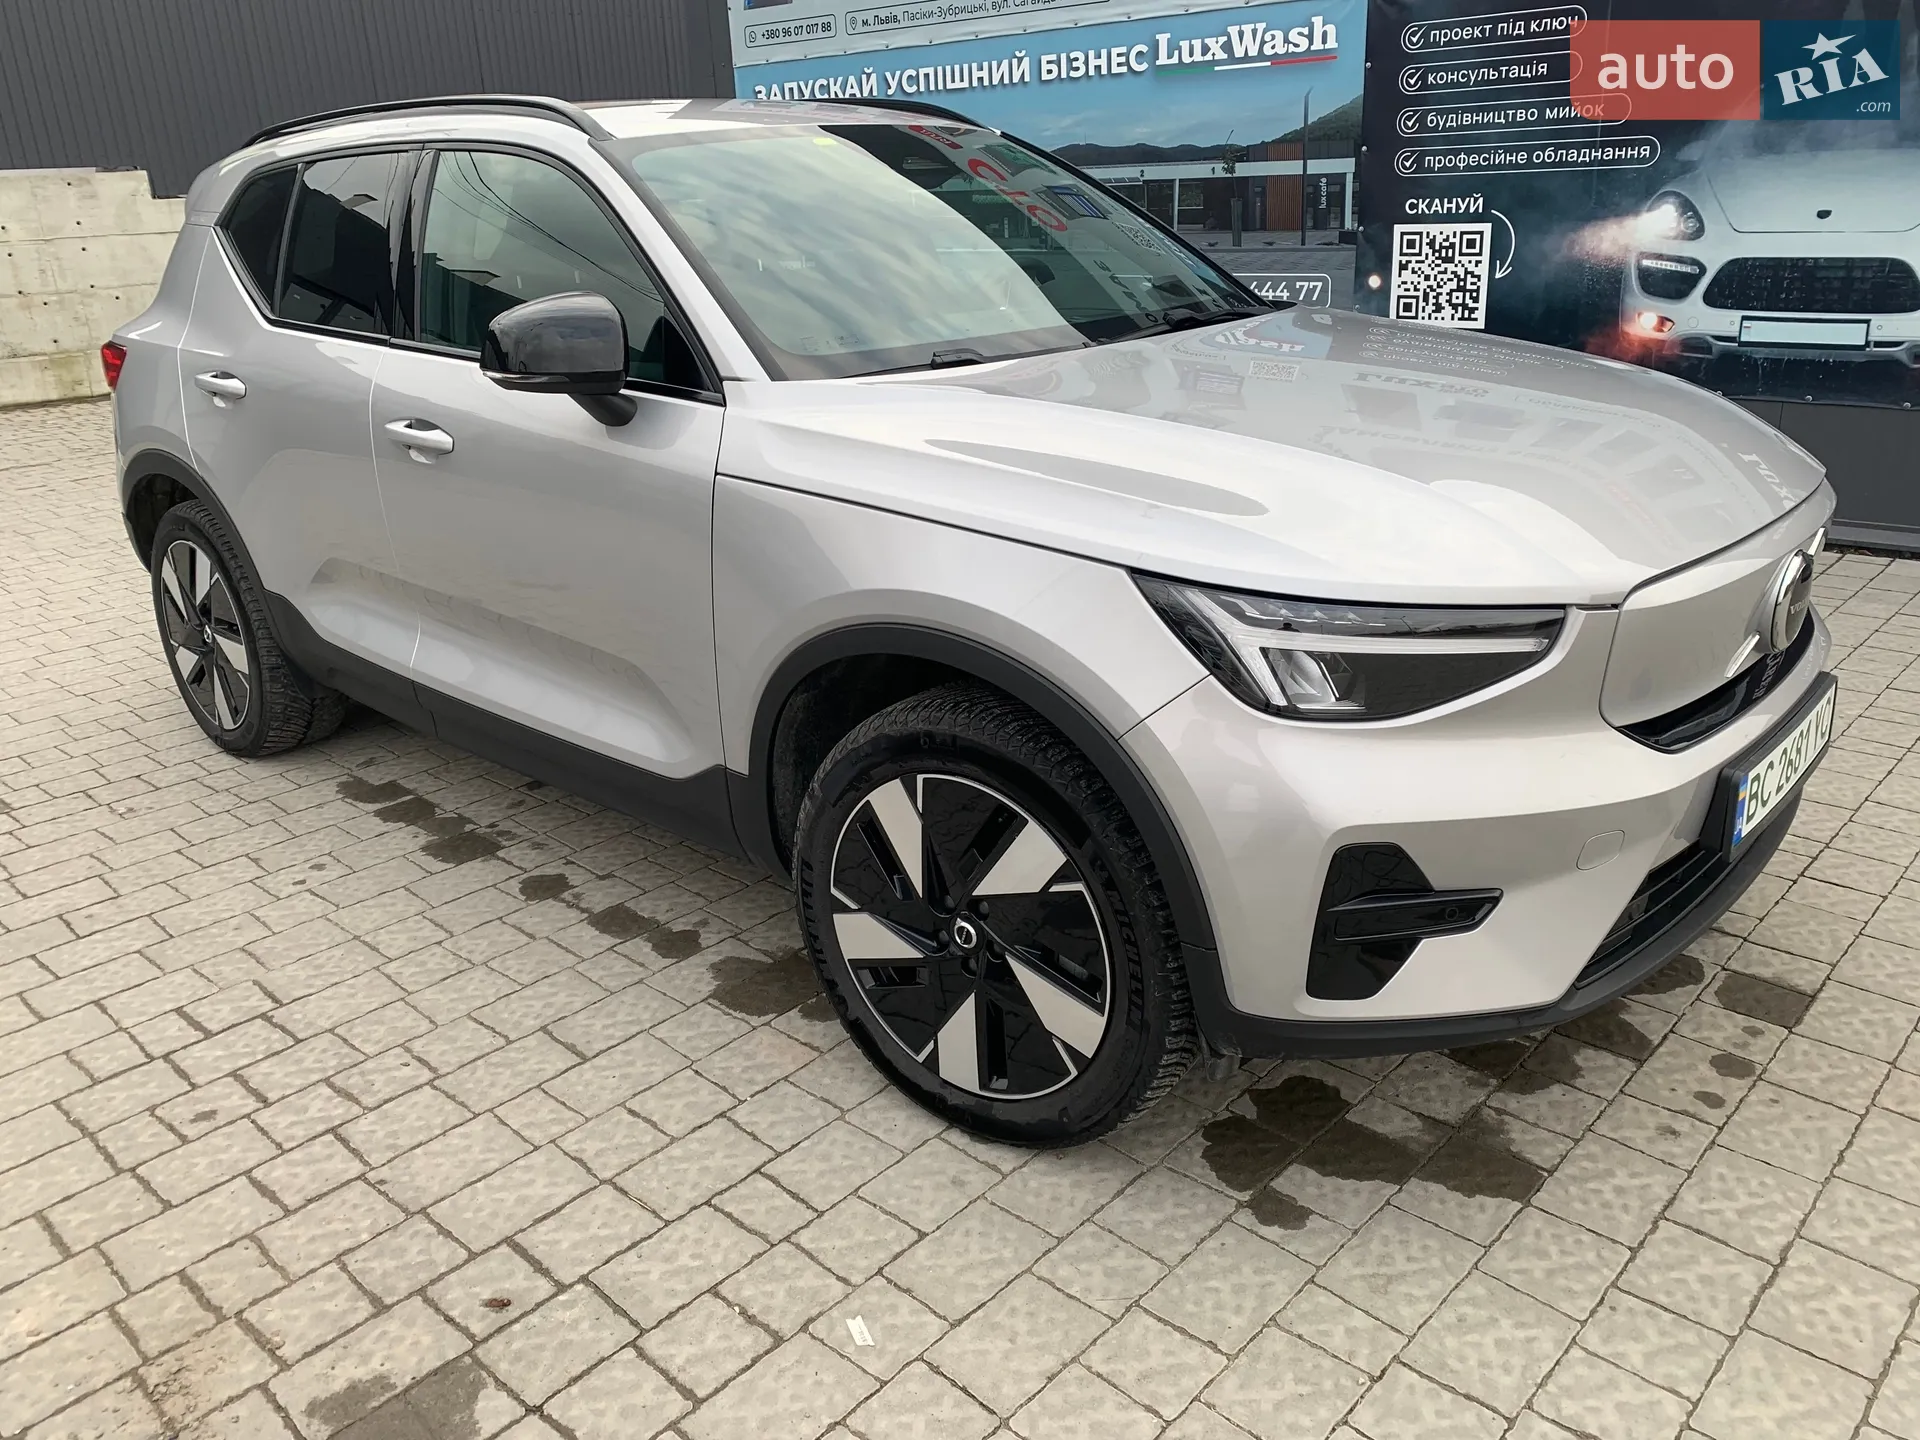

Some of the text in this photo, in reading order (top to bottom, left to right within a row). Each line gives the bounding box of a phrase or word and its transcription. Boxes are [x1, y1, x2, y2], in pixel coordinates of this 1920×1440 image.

[861, 19, 871, 27] м.
[873, 12, 901, 27] Львів,
[902, 0, 989, 22] Пасіки-Зубрицькі,
[761, 21, 832, 40] +380 96 07 017 88
[1154, 15, 1338, 66] LuxWash
[1430, 15, 1578, 46] проект під ключ
[754, 44, 1149, 100] ЗАПУСКАЙ УСПІШНИЙ БІЗНЕС
[1427, 61, 1548, 86] консультація
[1427, 101, 1604, 129] будівництво мийок
[1424, 144, 1650, 171] професійне обладнання
[1405, 193, 1484, 214] СКАНУЙ
[1295, 281, 1323, 300] 77
[1746, 696, 1831, 825] BC 2681 YC
